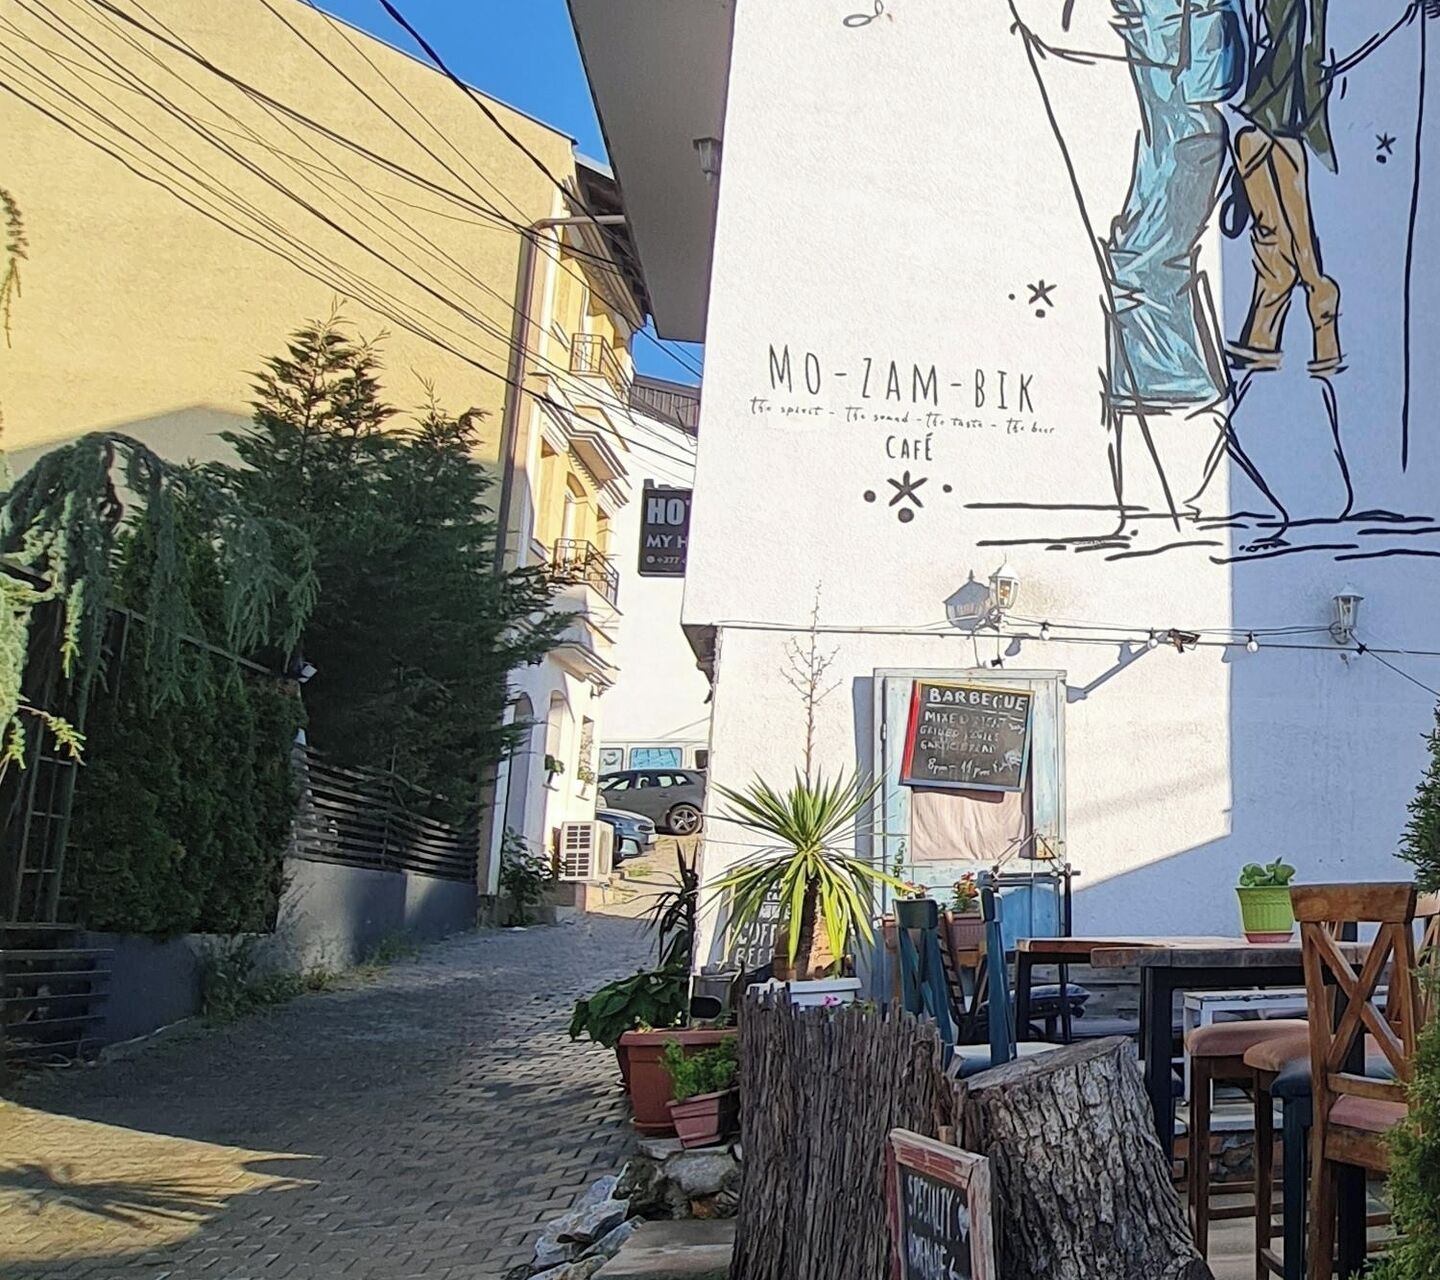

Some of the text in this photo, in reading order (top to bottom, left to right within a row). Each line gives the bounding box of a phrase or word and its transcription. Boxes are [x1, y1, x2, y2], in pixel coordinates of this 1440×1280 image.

[768, 344, 1034, 413] MO-ZAM-BIK
[886, 432, 934, 461] CAFÉ
[647, 497, 690, 526] HO
[646, 534, 673, 548] MY
[929, 687, 1028, 711] BARBECUE
[925, 711, 969, 725] MIXED
